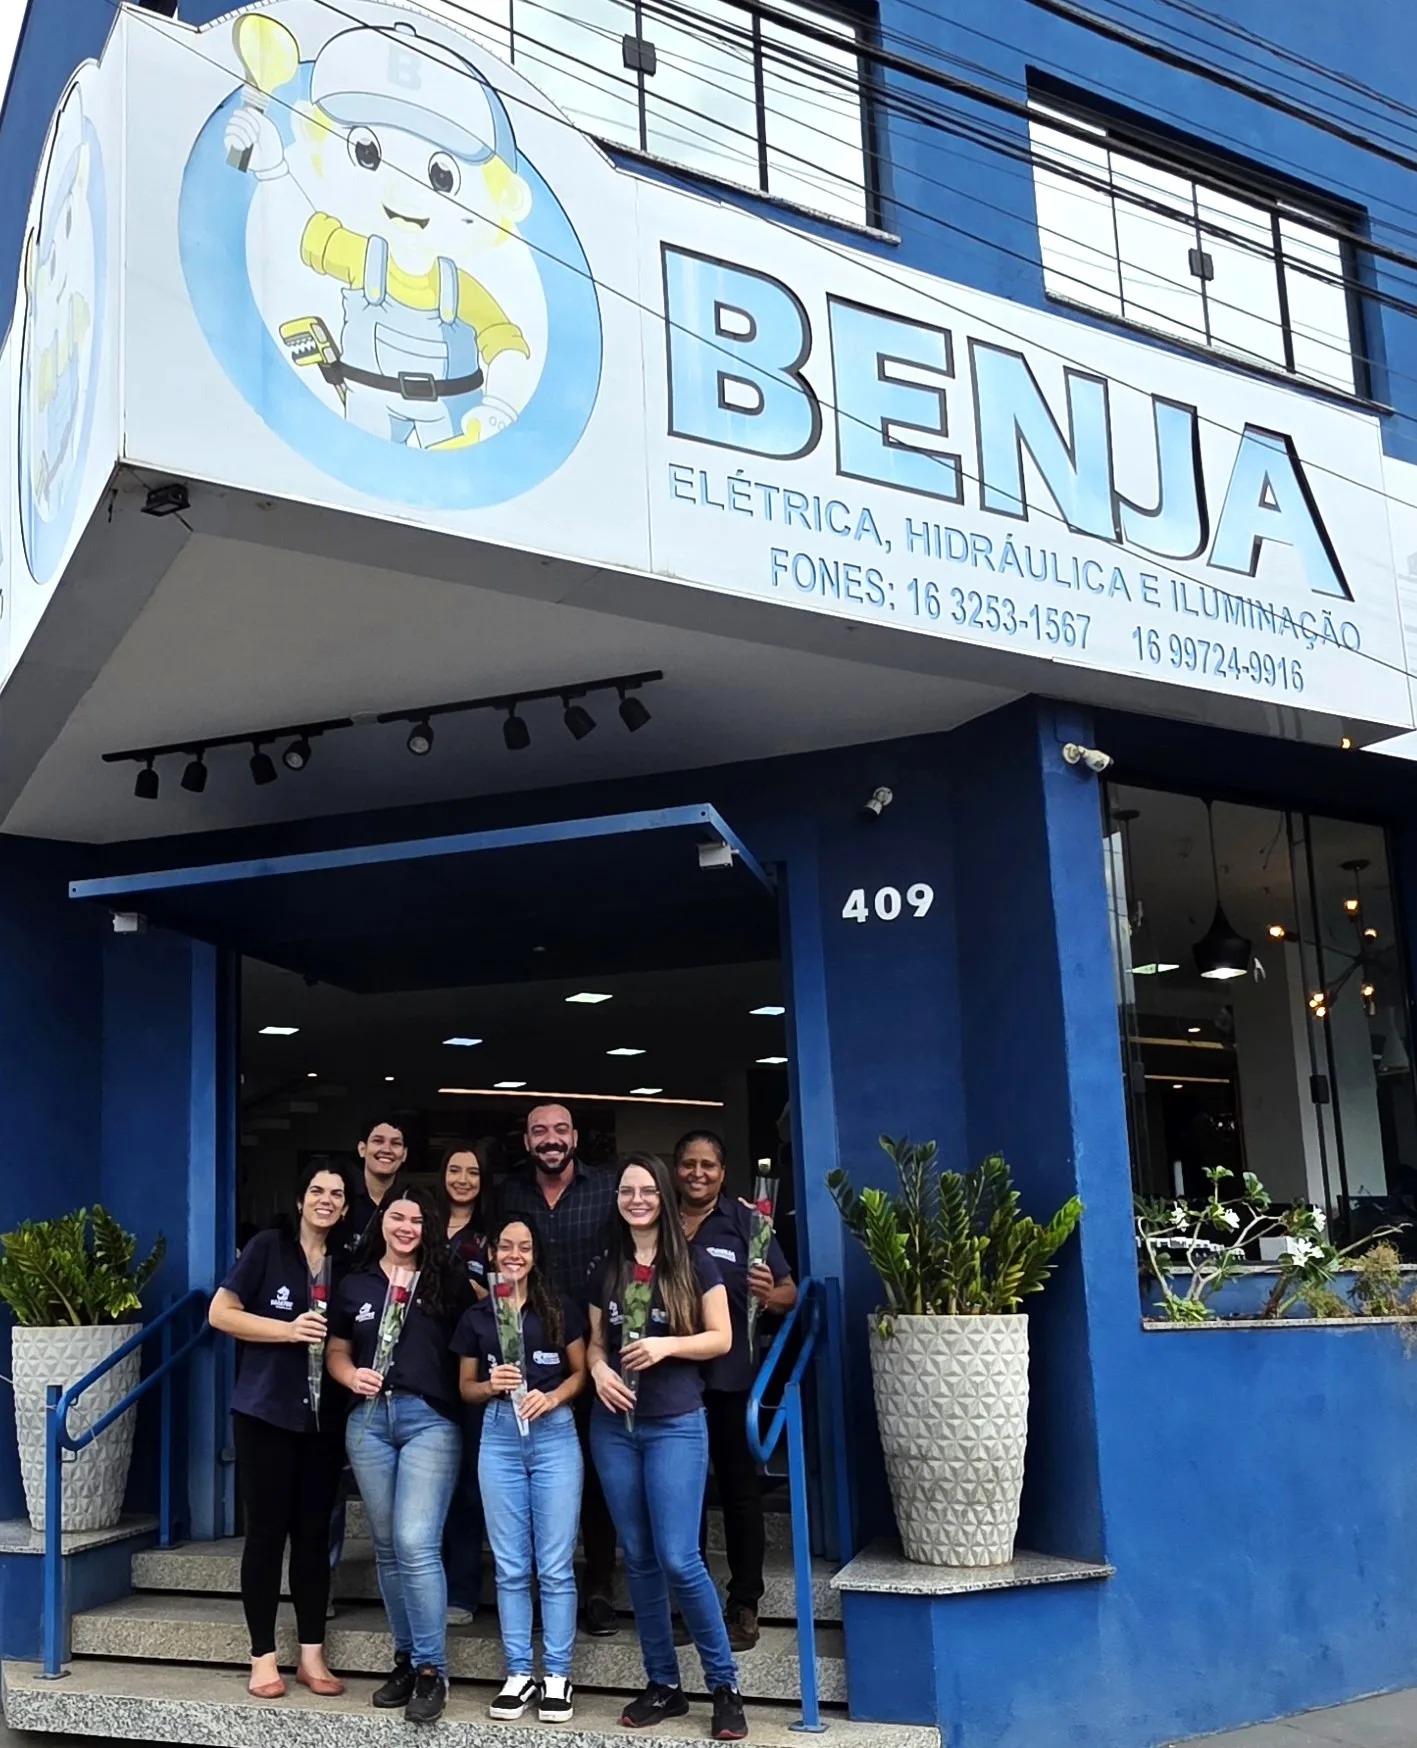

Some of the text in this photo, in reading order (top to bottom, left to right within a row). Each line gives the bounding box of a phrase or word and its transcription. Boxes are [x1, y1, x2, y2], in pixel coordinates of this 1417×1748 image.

[387, 44, 422, 91] B
[660, 240, 1355, 603] BENJA
[668, 462, 1362, 652] ELÉTRICA, HIDRÁULICA E ILUMINAÇÃO
[769, 547, 1305, 693] FONES: 16 3253-1567 16 99724-9916
[841, 882, 935, 923] 409
